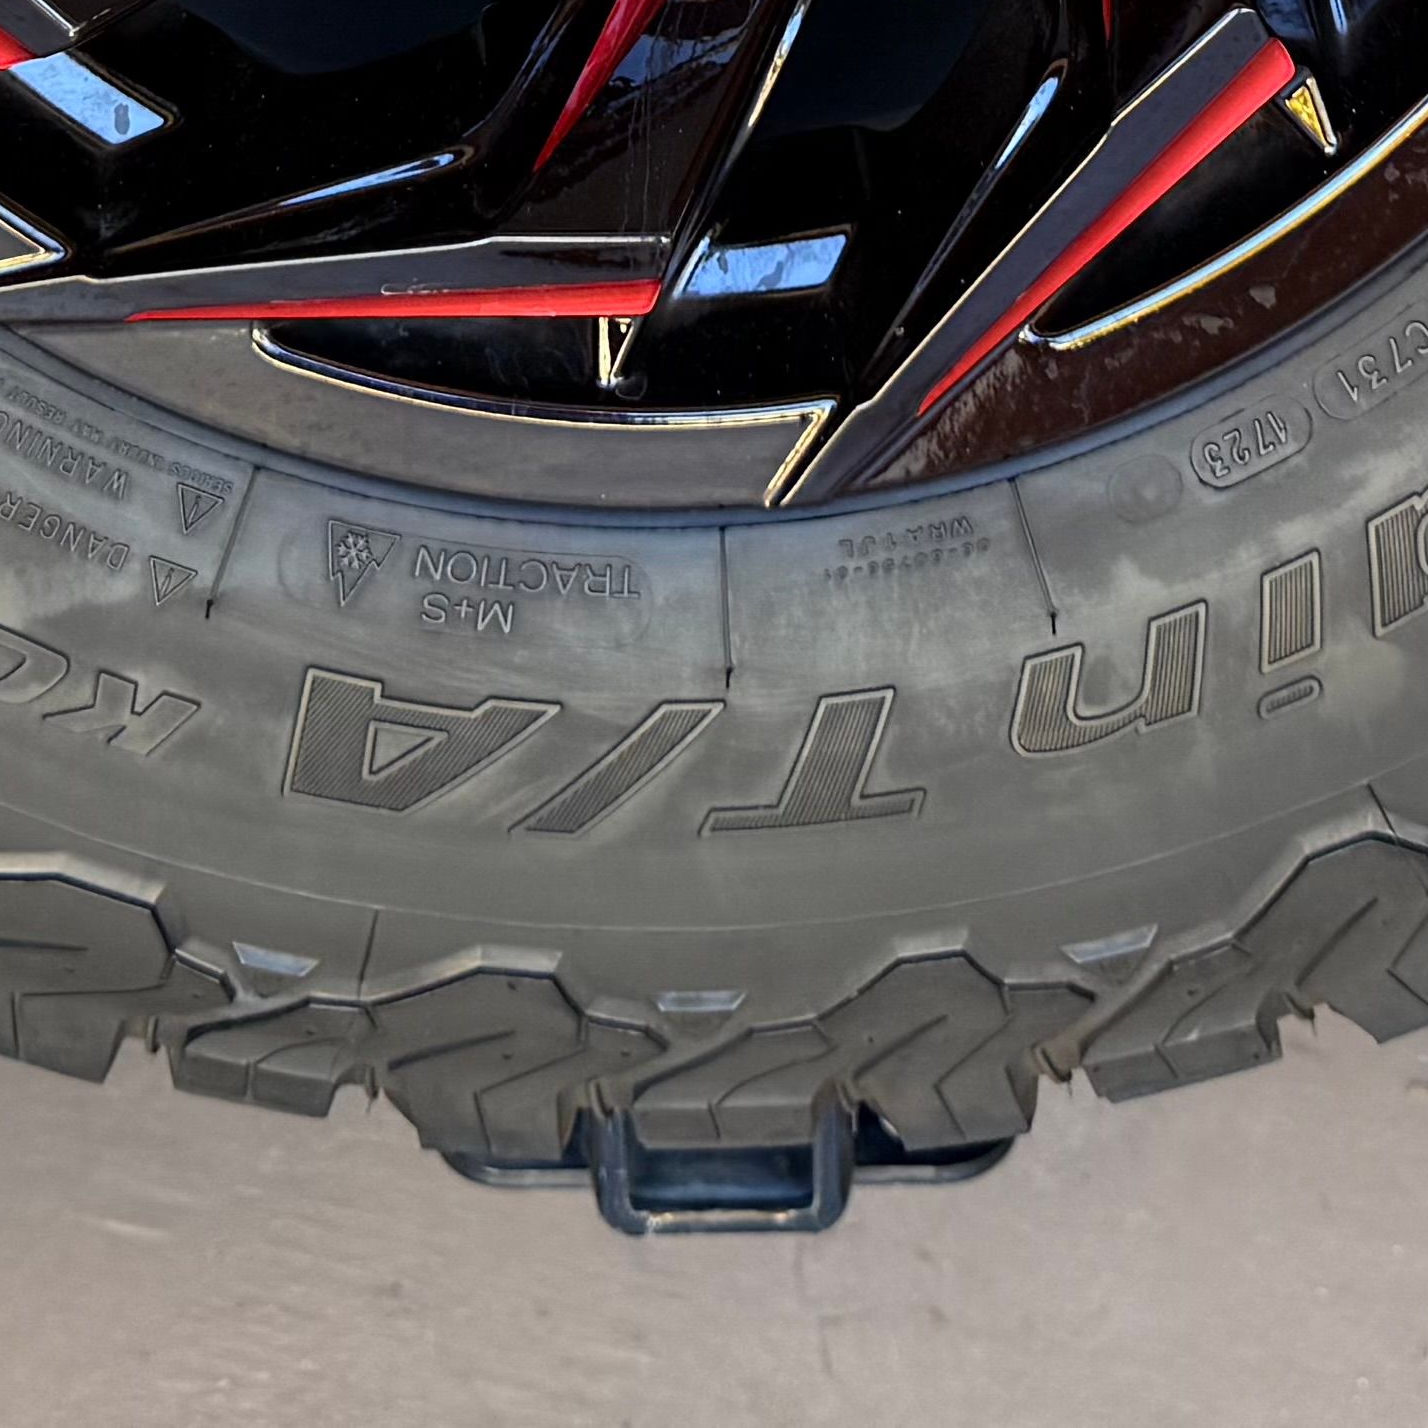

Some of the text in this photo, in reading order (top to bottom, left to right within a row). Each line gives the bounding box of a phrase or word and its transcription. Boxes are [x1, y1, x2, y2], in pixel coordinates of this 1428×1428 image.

[1201, 409, 1289, 481] 1723
[412, 542, 639, 598] TRACTION
[419, 591, 515, 633] M+S
[275, 665, 954, 838] T/A
